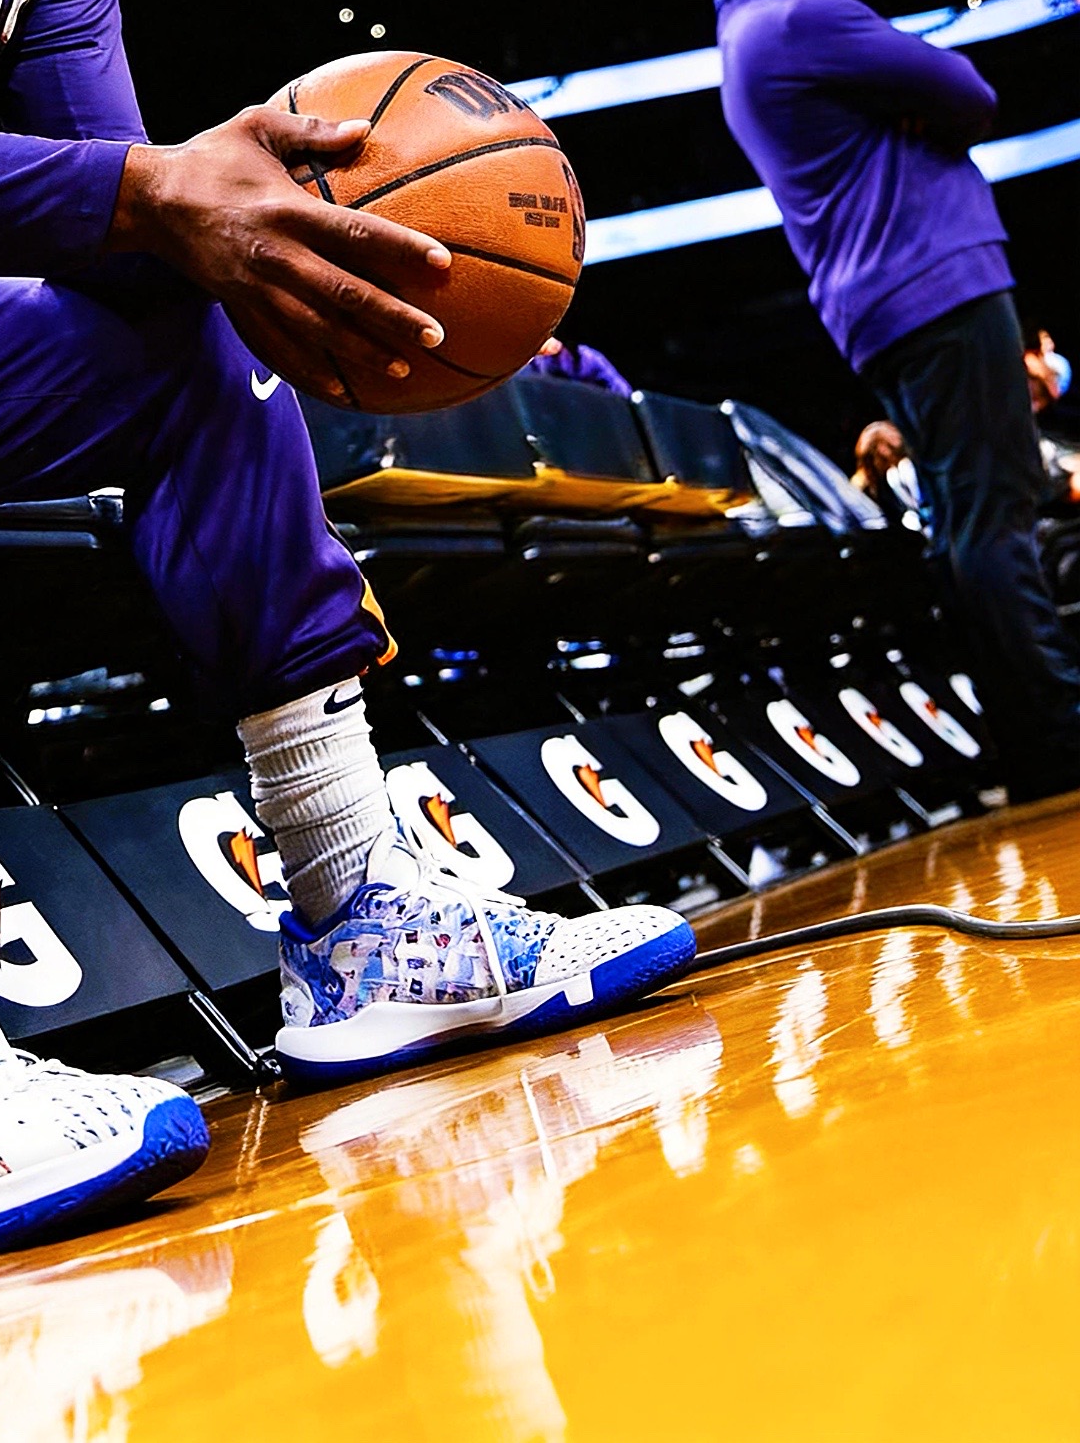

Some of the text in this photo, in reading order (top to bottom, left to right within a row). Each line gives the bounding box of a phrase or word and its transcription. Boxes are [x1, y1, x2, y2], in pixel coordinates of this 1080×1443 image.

[658, 711, 768, 812] G
[766, 699, 861, 787] G
[838, 688, 924, 767] G
[386, 761, 516, 891] G
[541, 734, 661, 847] G
